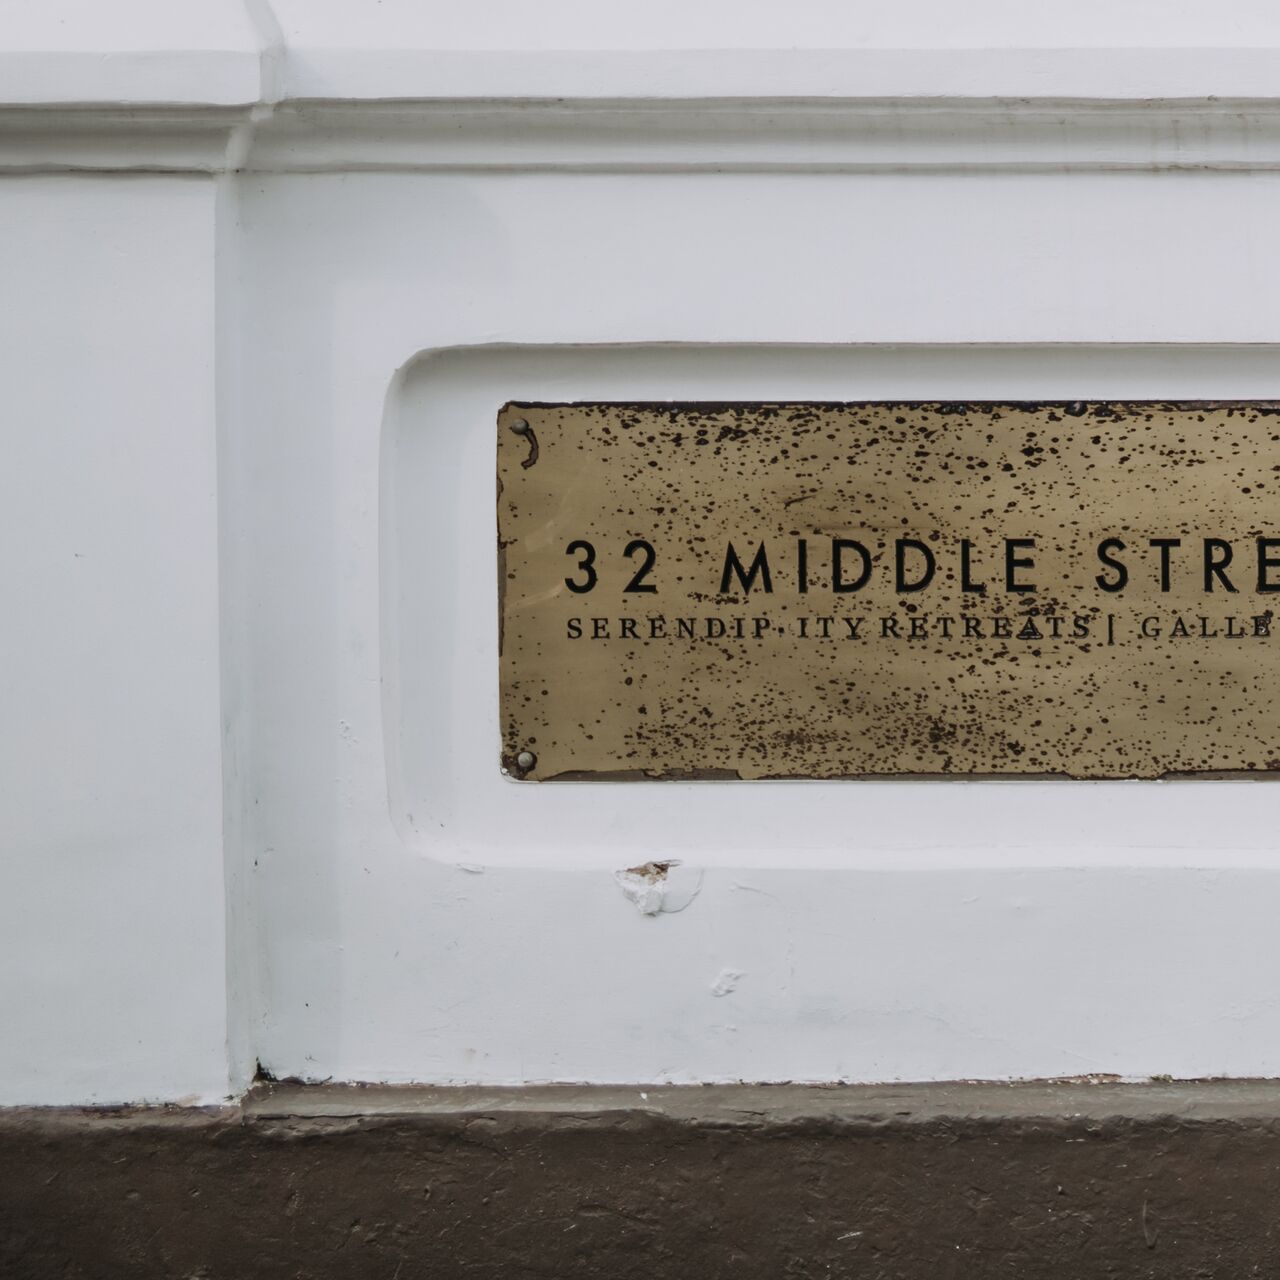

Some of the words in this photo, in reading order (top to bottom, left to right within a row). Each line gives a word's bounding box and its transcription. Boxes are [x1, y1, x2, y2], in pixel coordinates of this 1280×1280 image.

[564, 539, 658, 594] 32
[719, 538, 1036, 595] MIDDLE
[878, 616, 1091, 640] RETREATS
[1141, 616, 1271, 639] GALLE
